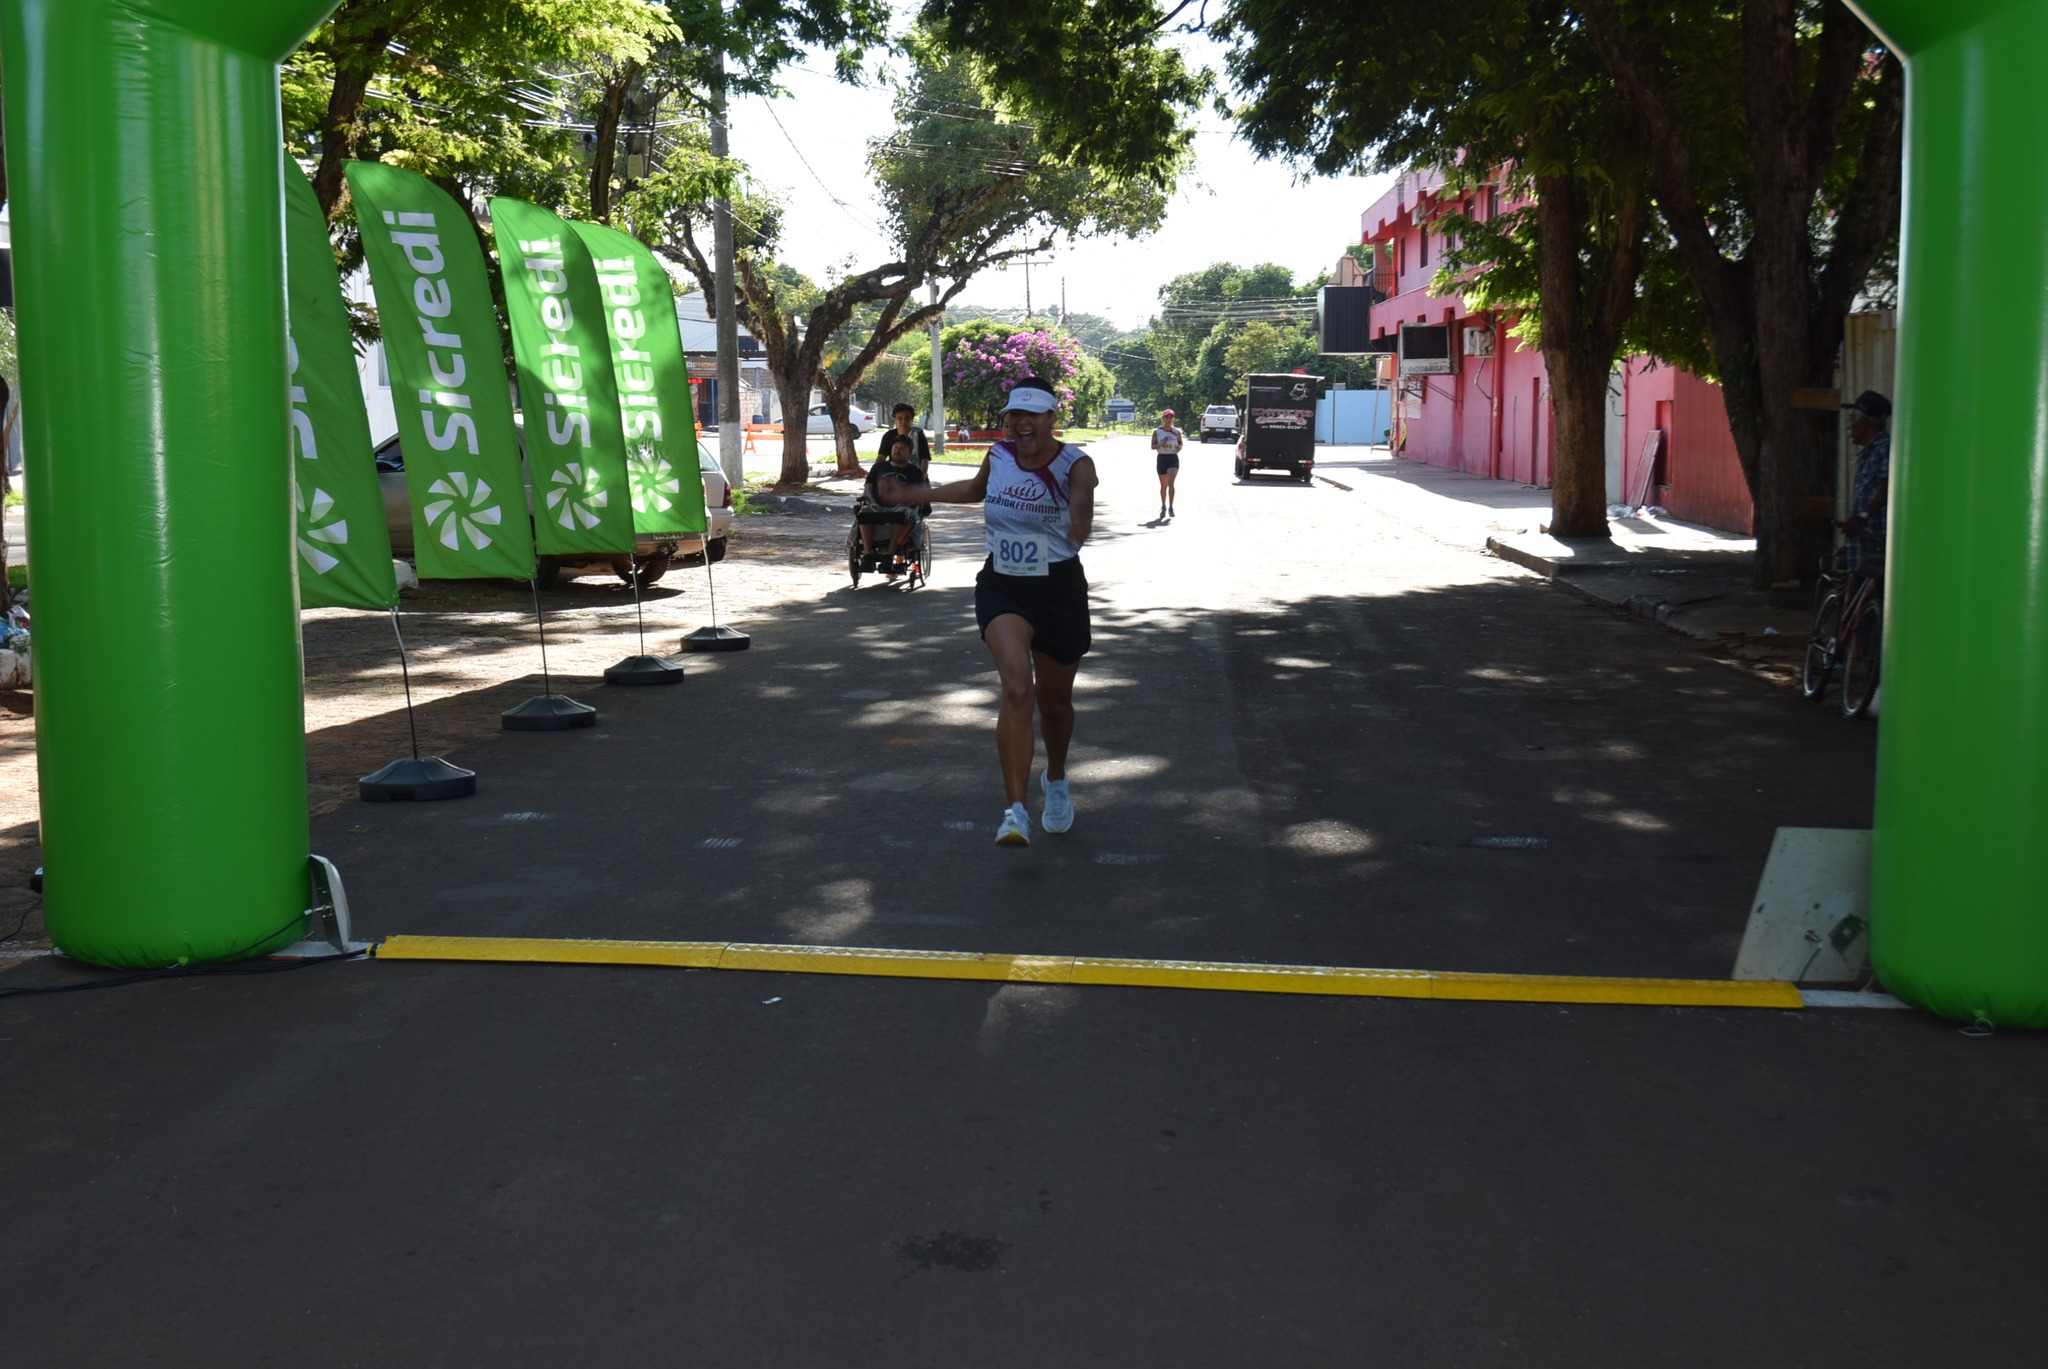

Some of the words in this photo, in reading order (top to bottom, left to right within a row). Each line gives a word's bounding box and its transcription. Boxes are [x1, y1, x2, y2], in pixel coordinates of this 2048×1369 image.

[383, 210, 479, 455] Sicredi
[519, 235, 591, 448] Sicredi
[593, 256, 663, 442] Sicredi
[1000, 539, 1038, 563] 802
[1016, 501, 1060, 514] FEMININA
